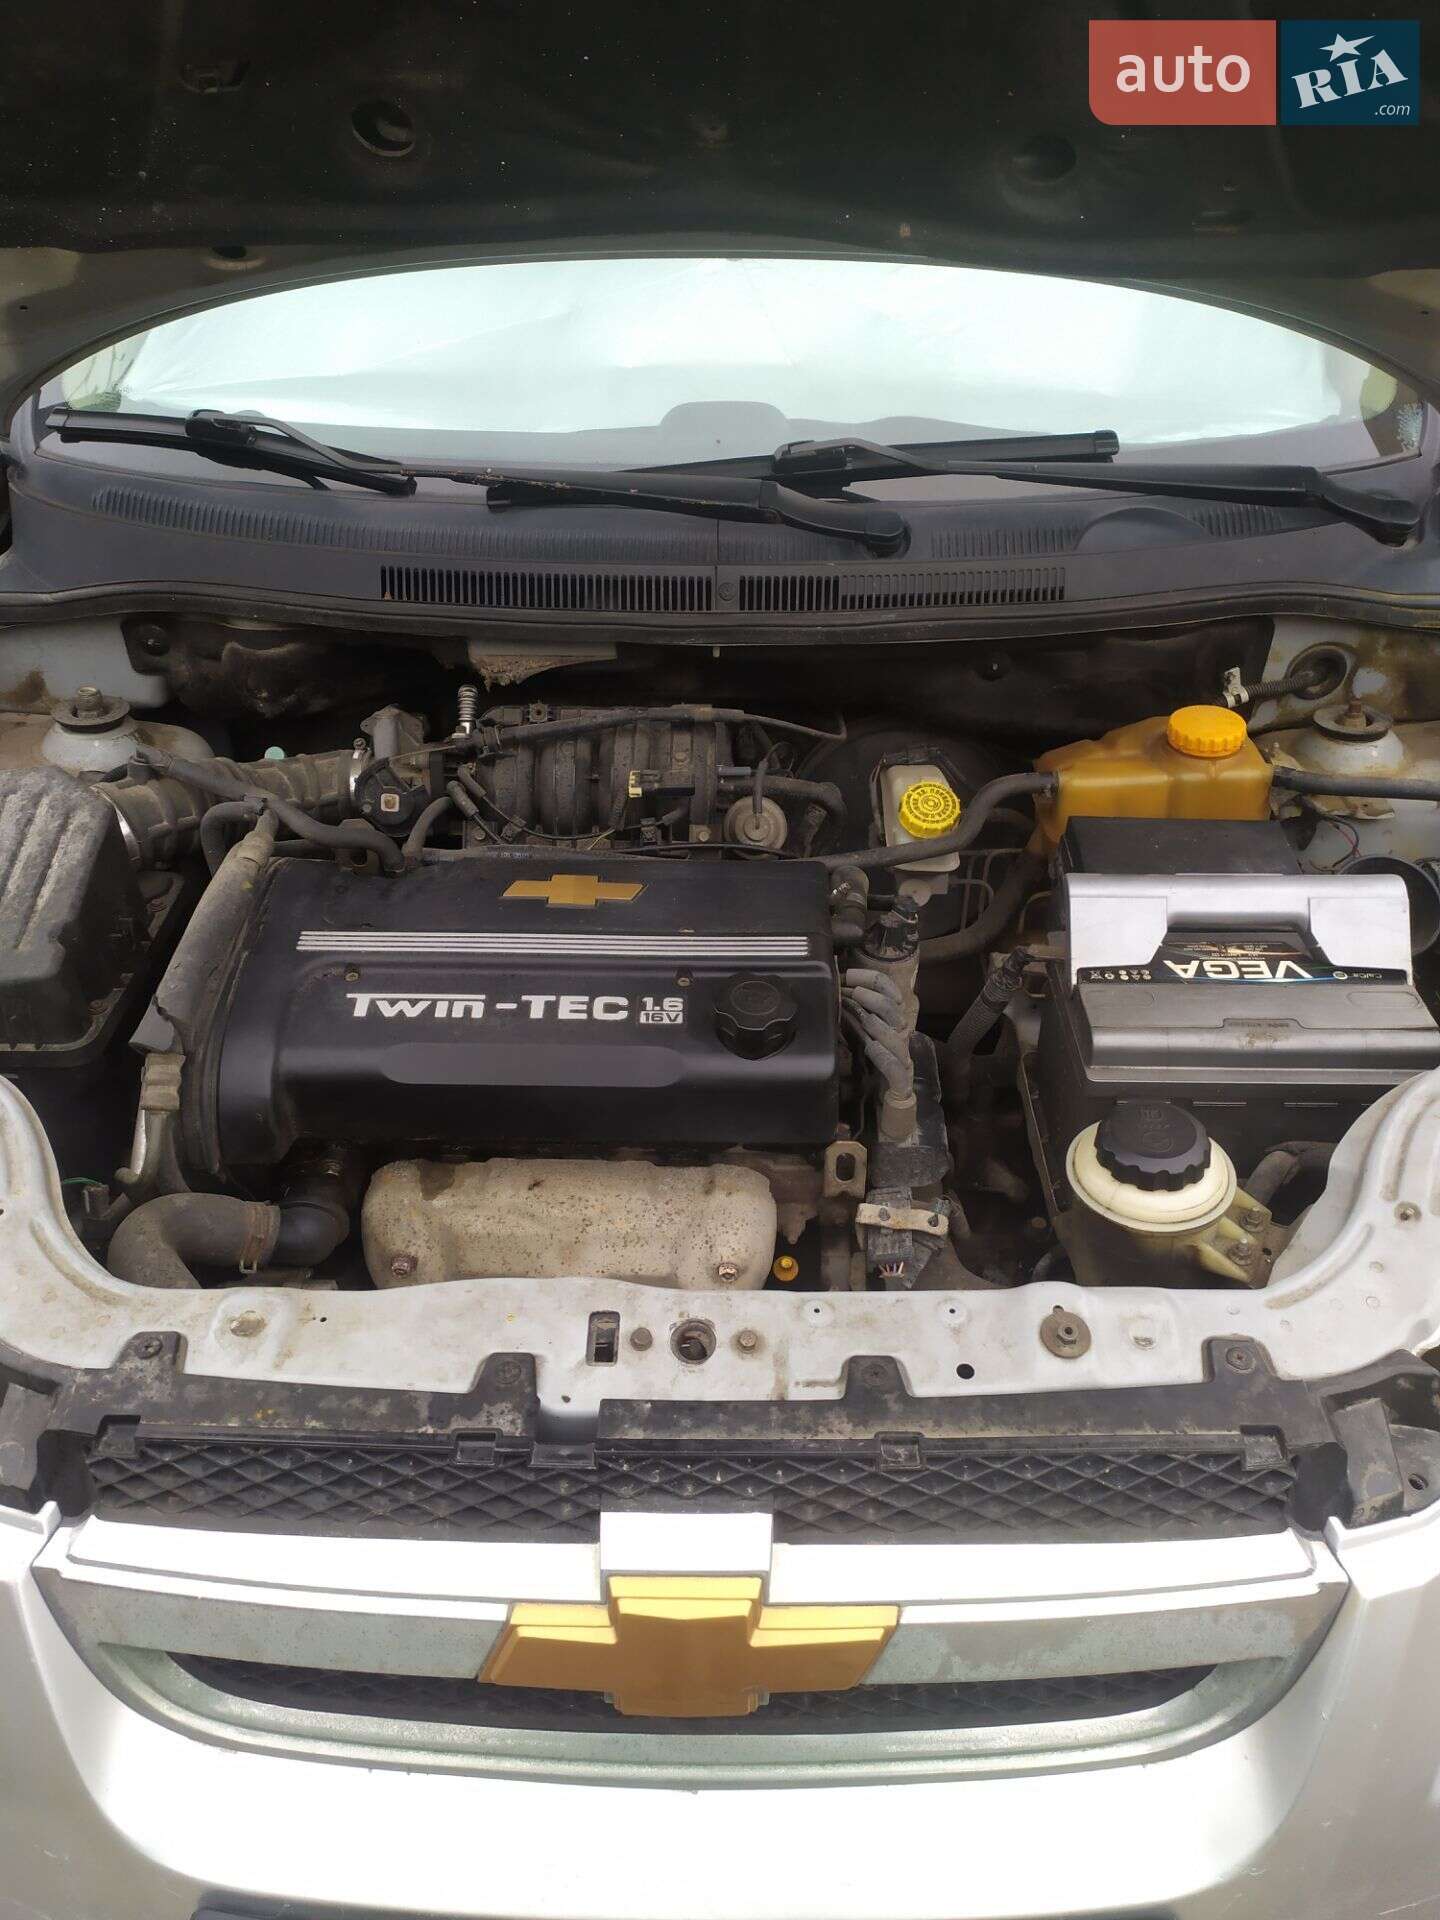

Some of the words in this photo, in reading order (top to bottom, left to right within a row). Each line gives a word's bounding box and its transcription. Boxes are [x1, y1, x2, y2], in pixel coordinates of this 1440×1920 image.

[1163, 960, 1313, 979] VEGA
[641, 997, 684, 1011] 1.6
[640, 1011, 683, 1024] 16V
